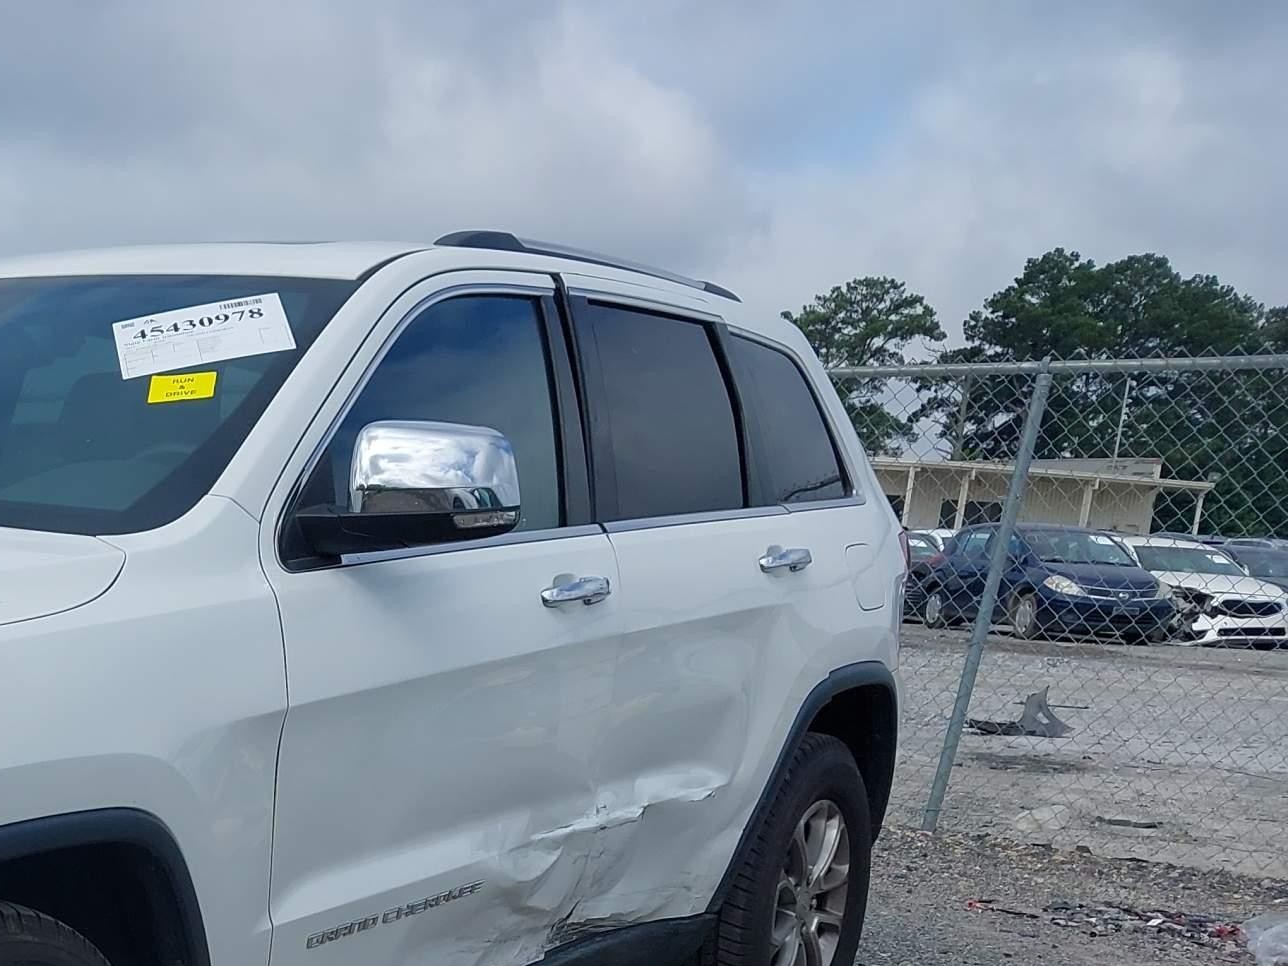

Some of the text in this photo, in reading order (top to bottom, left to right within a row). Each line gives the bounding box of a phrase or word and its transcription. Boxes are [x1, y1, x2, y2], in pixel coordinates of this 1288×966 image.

[133, 307, 264, 340] 45430978
[165, 389, 198, 398] DRIVE
[306, 879, 486, 949] GRAND CHEROKEE
